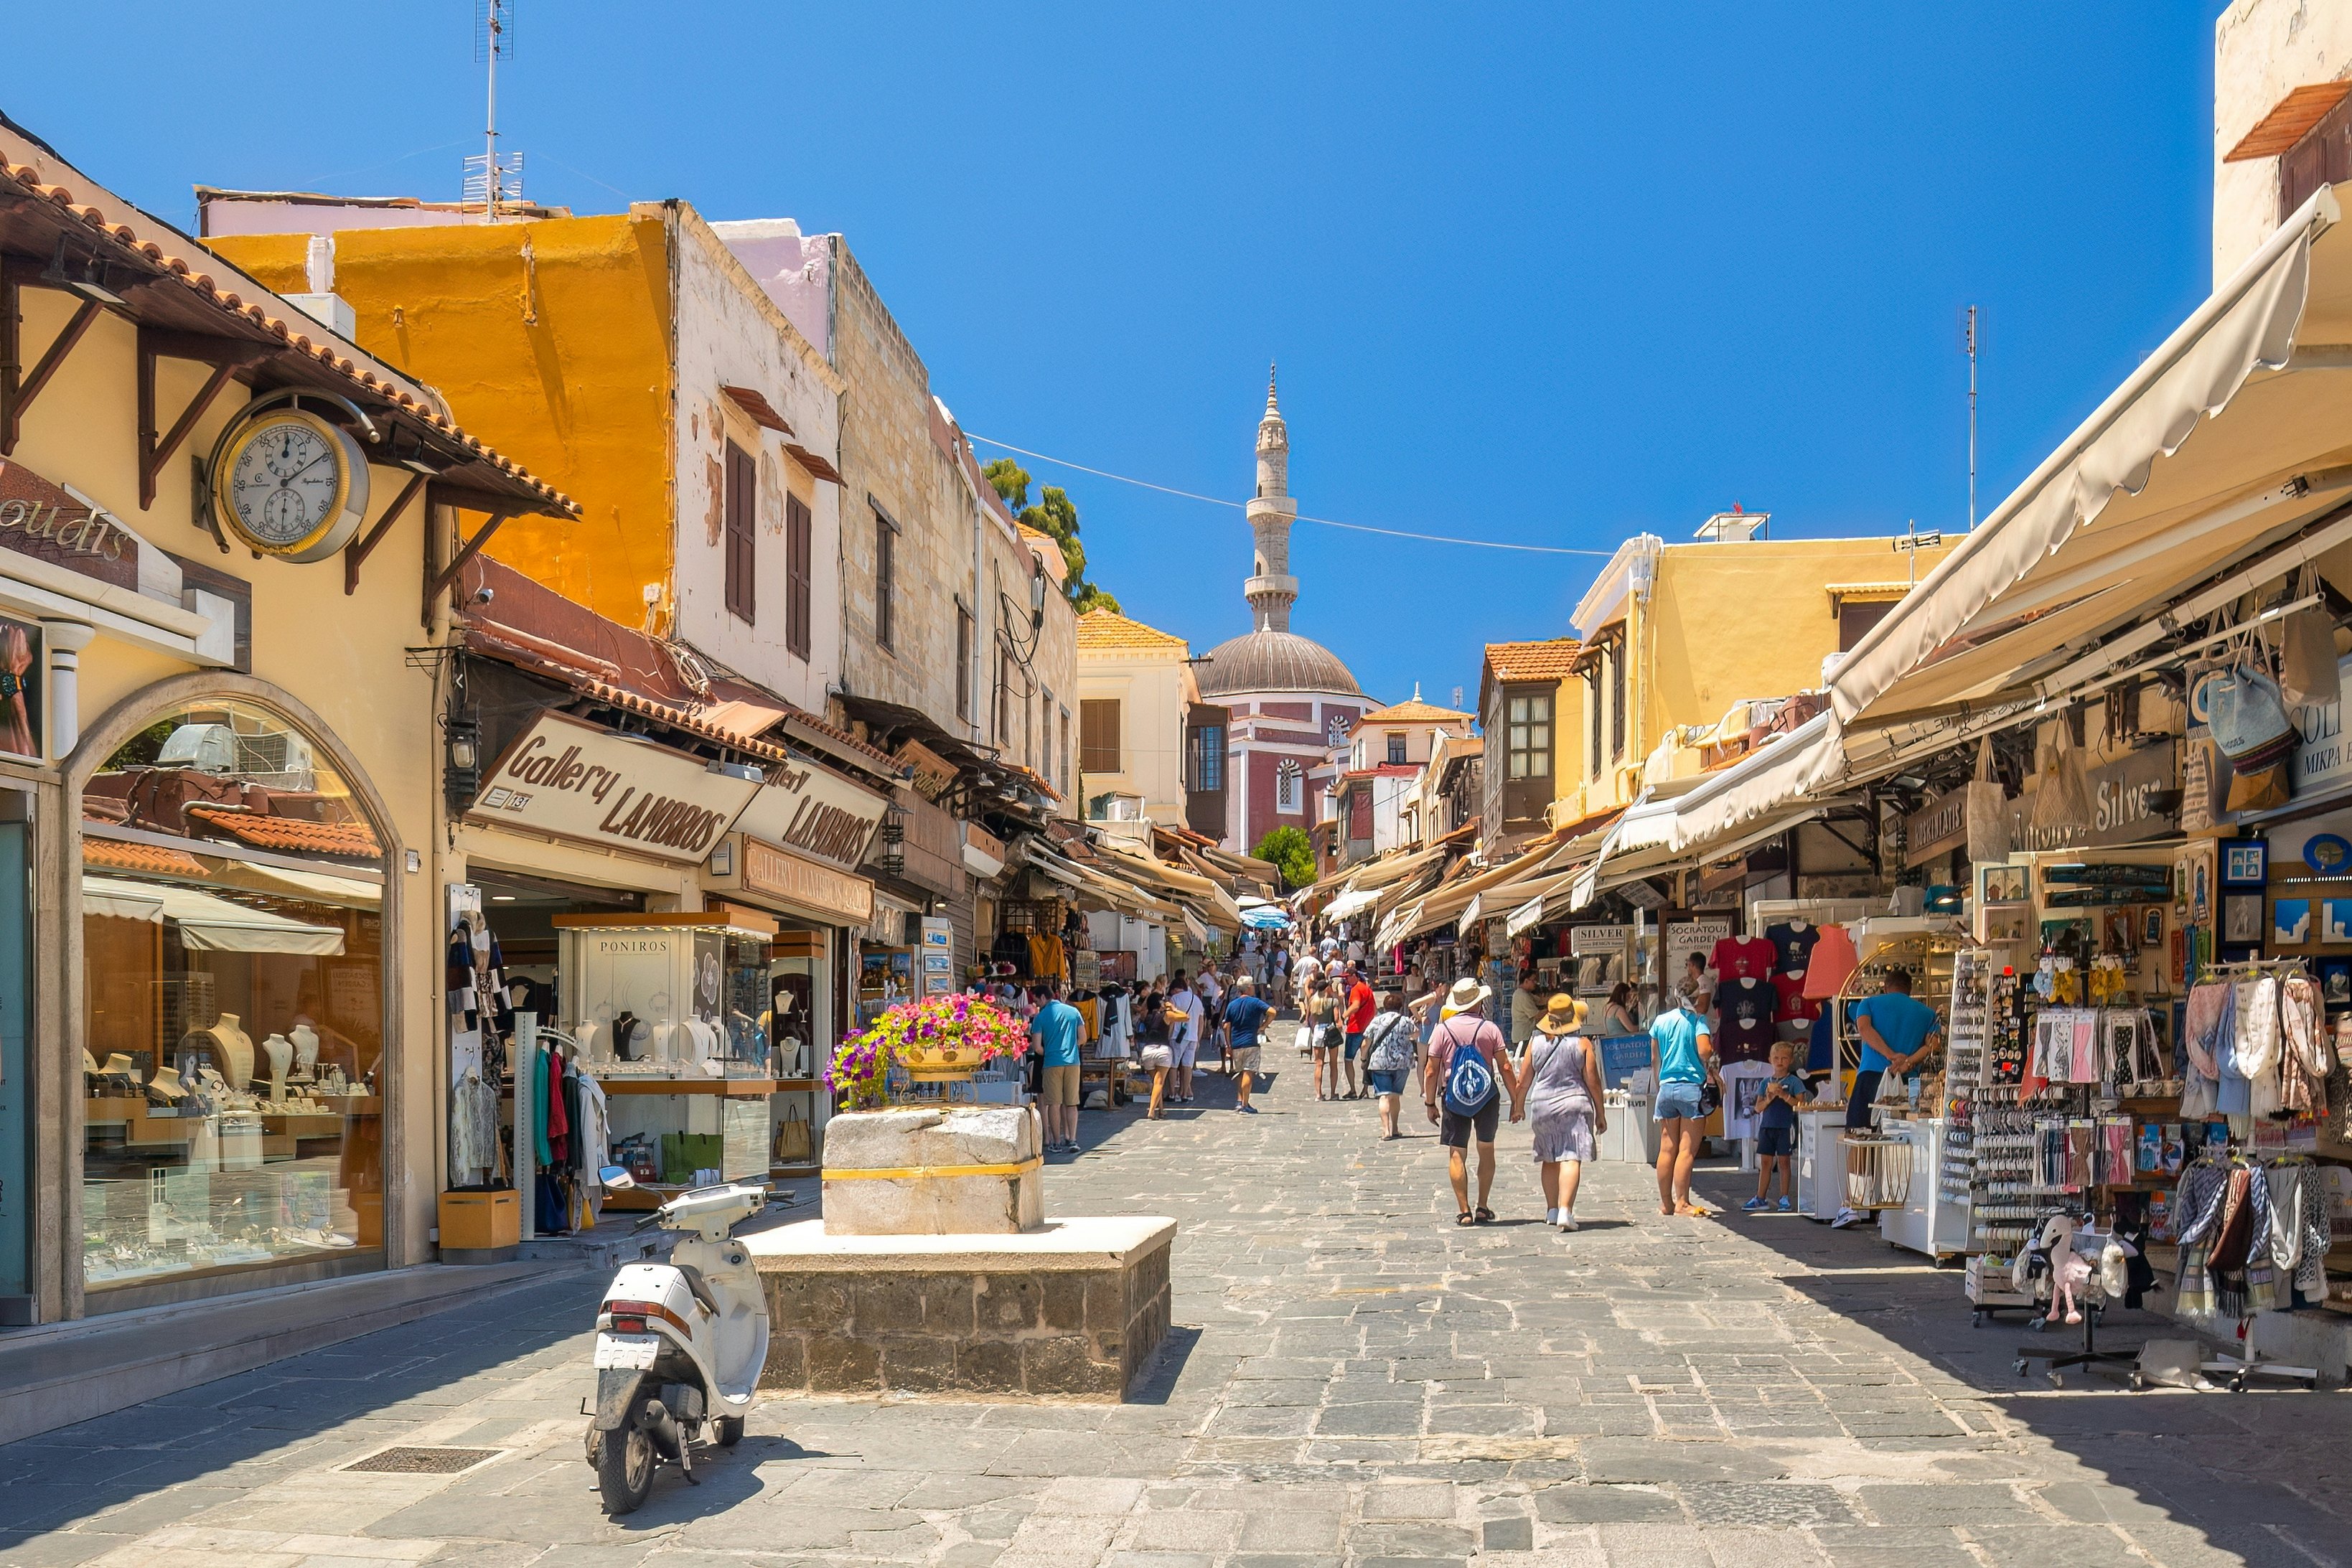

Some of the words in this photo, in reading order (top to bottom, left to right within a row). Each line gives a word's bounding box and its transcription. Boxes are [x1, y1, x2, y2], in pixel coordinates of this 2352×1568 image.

[238, 479, 245, 492] 45
[325, 477, 334, 487] 15
[243, 504, 252, 515] 40
[318, 499, 328, 512] 20
[507, 736, 622, 804] Gallery
[511, 797, 530, 807] 131
[599, 787, 727, 853] LAMBROS
[782, 794, 876, 864] LAMBROS
[748, 849, 795, 891] GALLERY
[798, 866, 843, 906] LAMBROS
[1580, 929, 1623, 939] SILVER
[1671, 925, 1728, 934] SOCRATOUS
[1679, 935, 1720, 944] GARDEN
[600, 942, 666, 952] PONIROS
[1612, 1051, 1646, 1060] GARDEN
